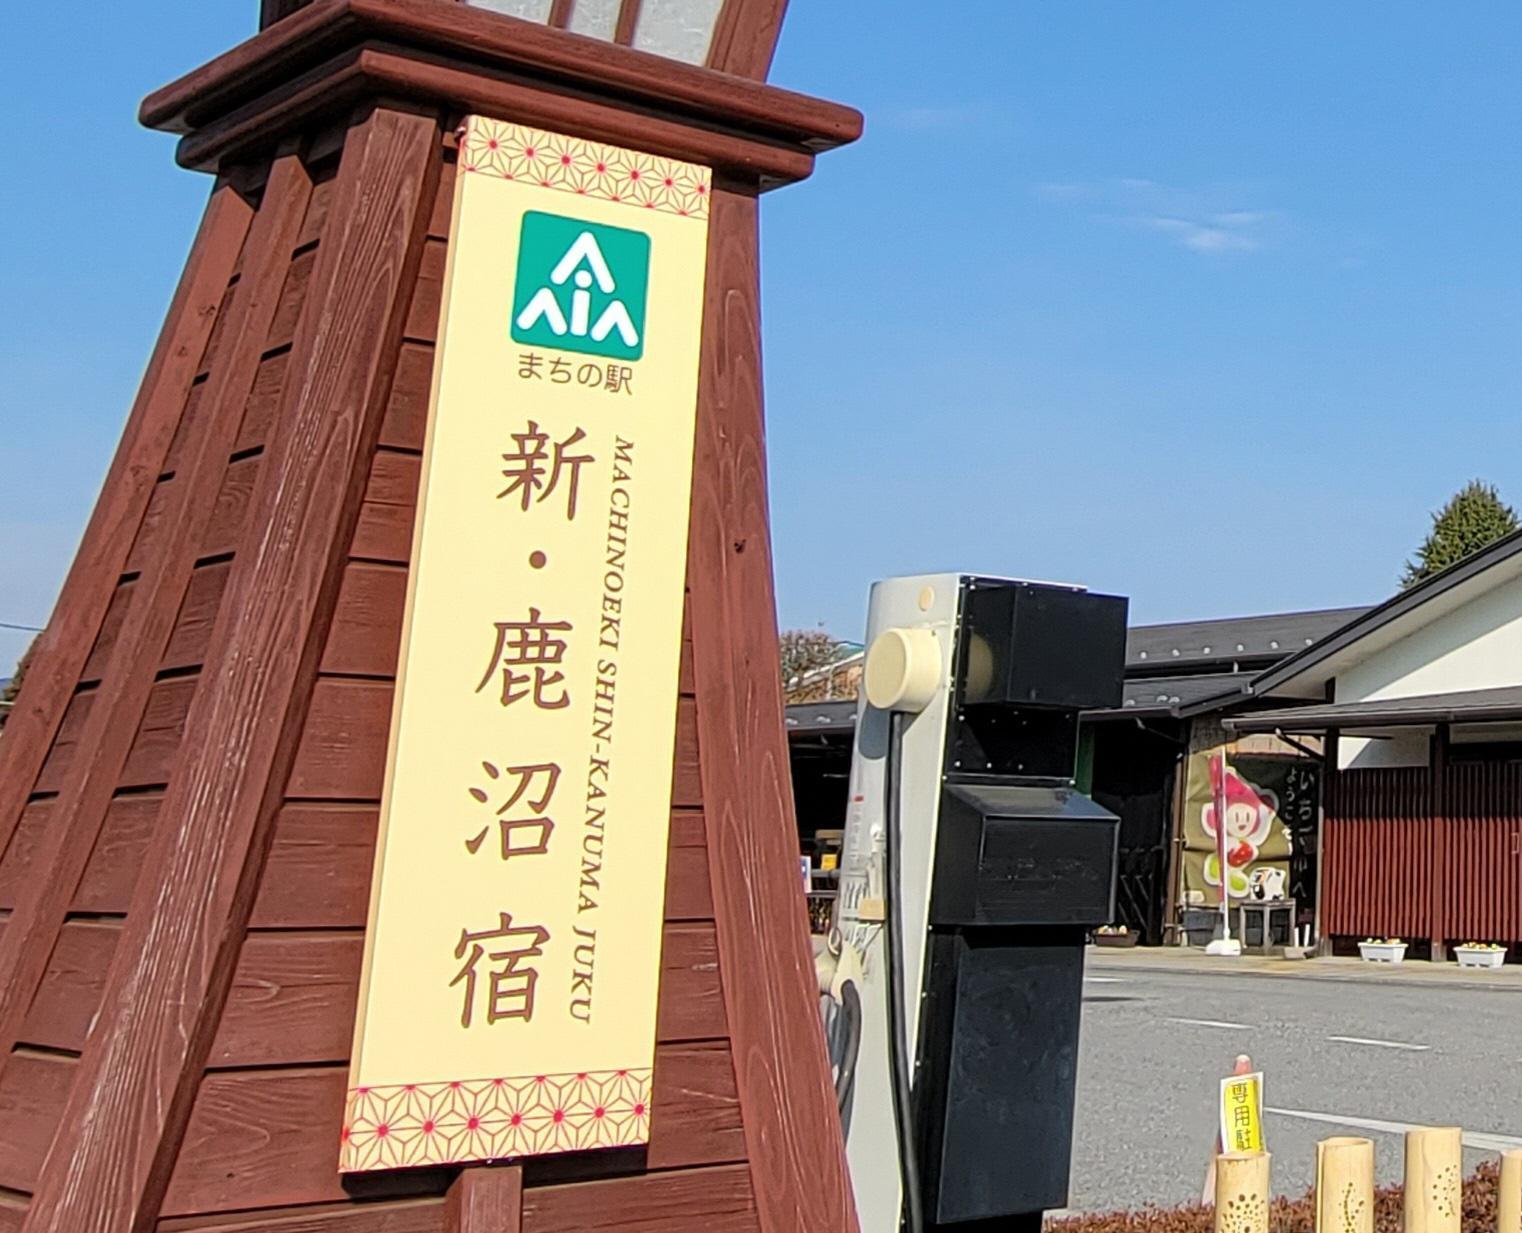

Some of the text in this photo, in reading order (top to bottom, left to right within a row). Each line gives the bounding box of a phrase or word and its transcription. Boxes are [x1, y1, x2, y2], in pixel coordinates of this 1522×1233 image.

[517, 351, 634, 396] まちの駅
[569, 434, 635, 1024] MACHINOEKI SHIN-KANUMA JUKU
